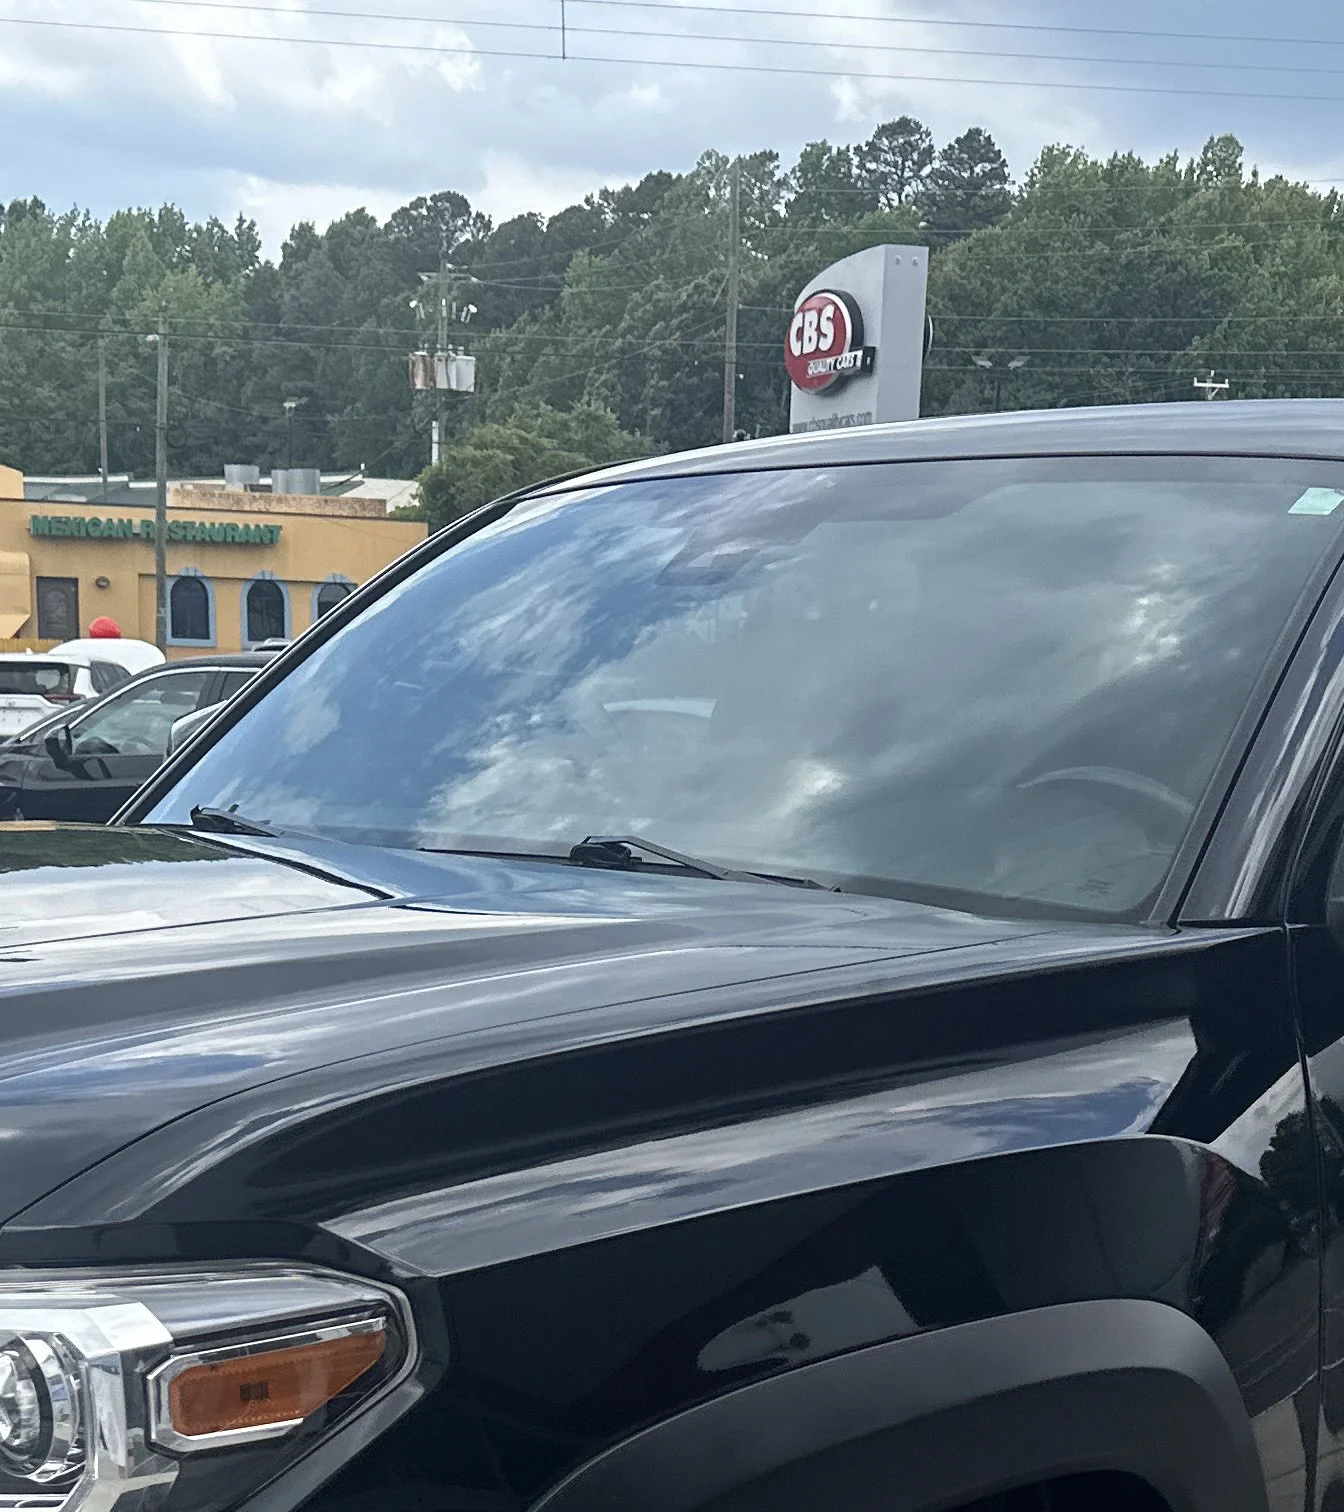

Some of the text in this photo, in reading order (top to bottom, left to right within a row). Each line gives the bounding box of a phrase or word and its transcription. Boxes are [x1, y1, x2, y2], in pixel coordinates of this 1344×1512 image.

[789, 304, 835, 357] CBS
[30, 514, 283, 545] MEXICAN RSTAURANT
